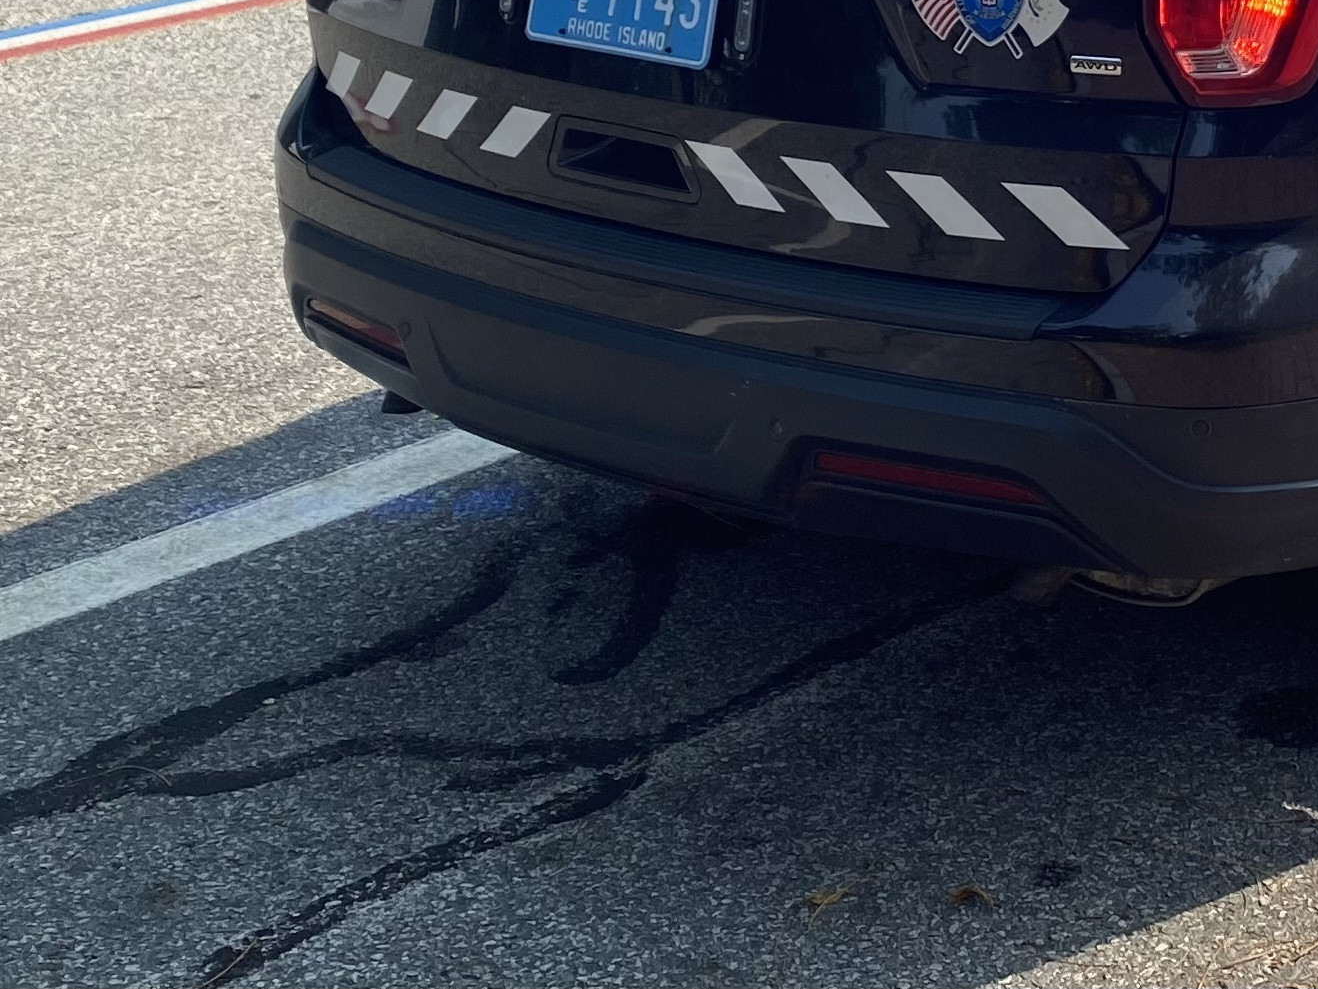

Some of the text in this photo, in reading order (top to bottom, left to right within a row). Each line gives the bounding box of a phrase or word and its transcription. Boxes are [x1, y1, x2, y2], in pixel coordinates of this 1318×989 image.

[567, 17, 666, 50] RHODE ISLAND
[1074, 60, 1117, 71] AWD
